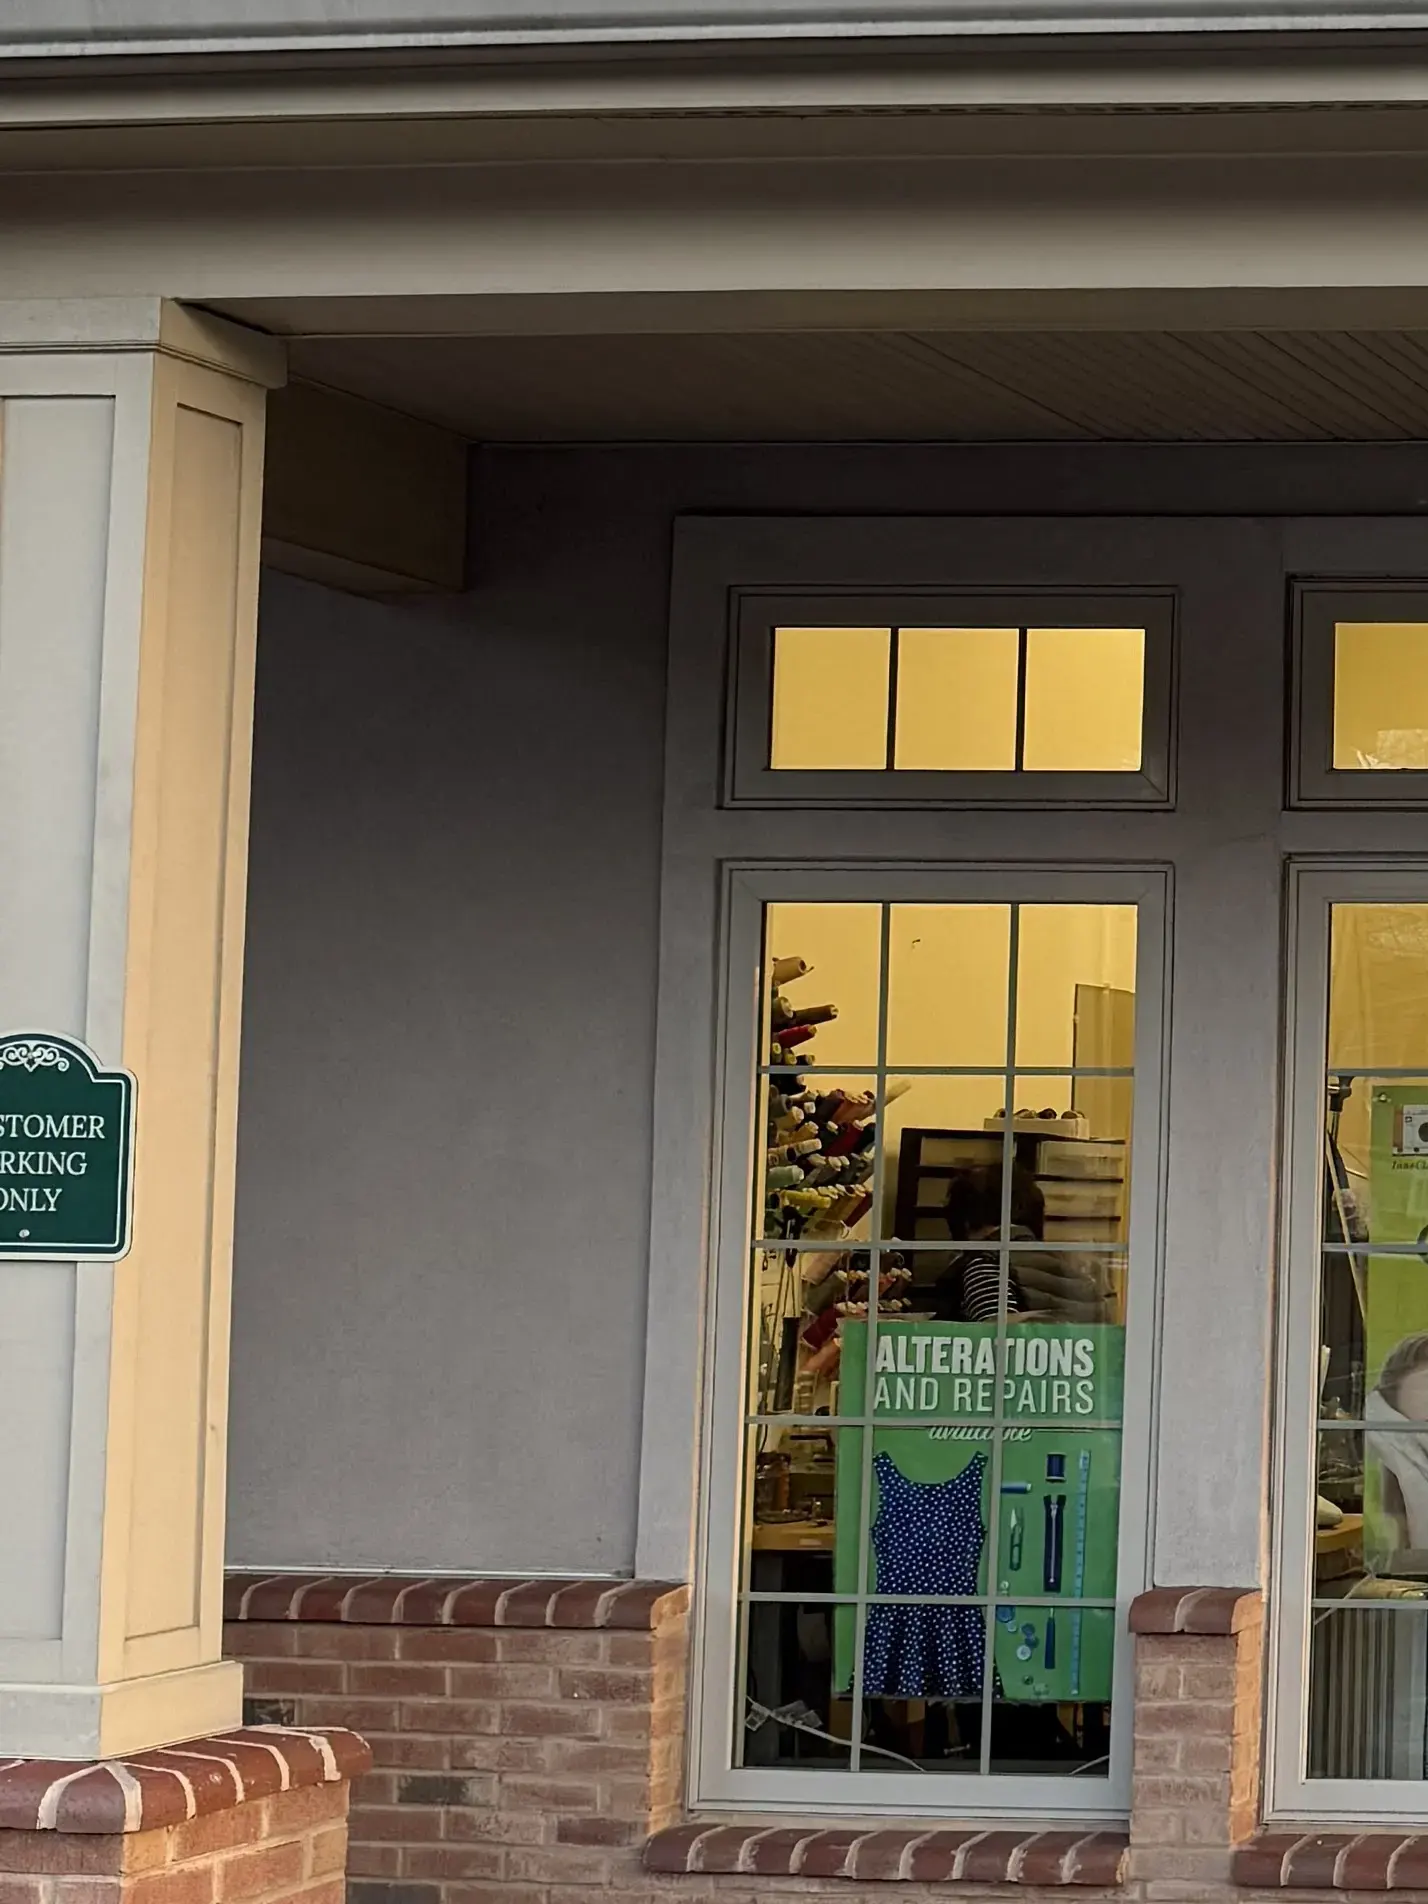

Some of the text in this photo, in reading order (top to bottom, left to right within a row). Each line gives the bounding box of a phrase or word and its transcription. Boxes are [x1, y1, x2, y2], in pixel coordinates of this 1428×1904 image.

[875, 1335, 1095, 1377] ALTERATIONS
[873, 1377, 1094, 1414] AND REPAIRS
